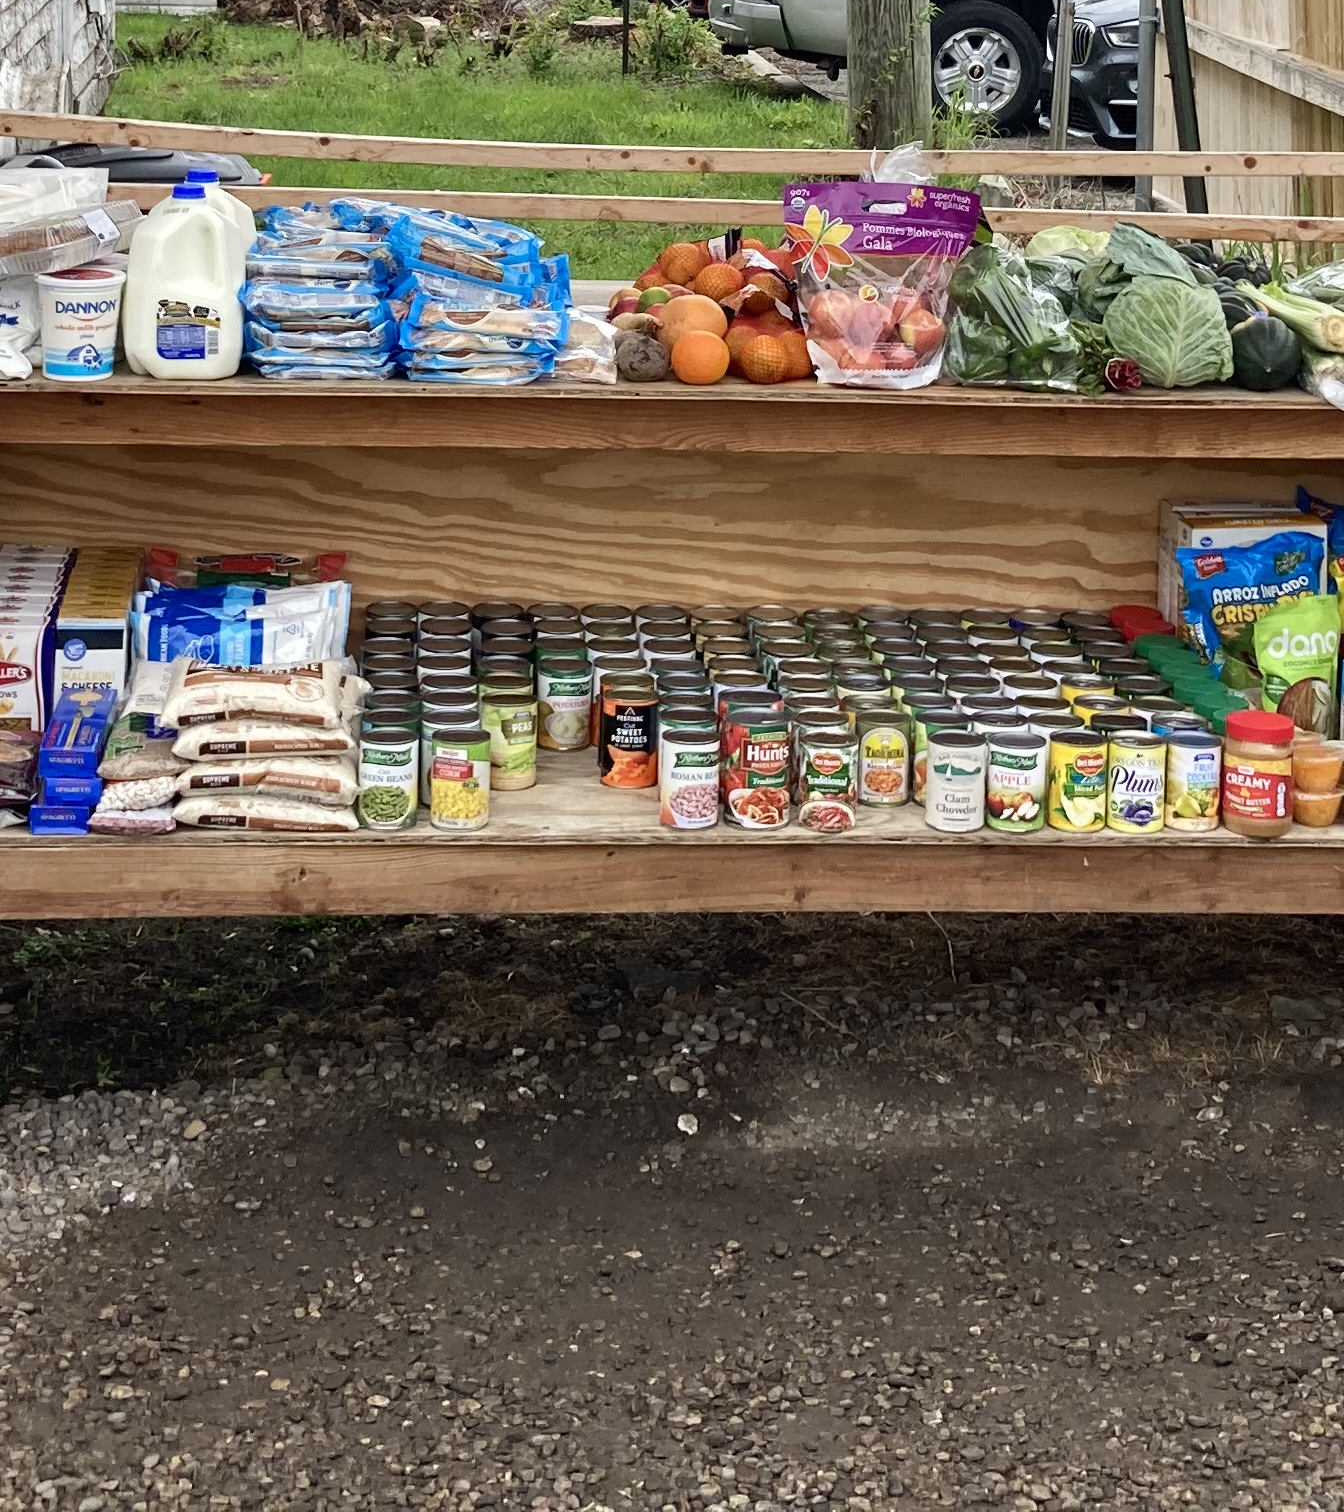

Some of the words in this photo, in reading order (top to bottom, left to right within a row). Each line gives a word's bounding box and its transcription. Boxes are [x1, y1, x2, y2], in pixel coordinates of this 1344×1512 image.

[929, 191, 972, 206] superfresh
[934, 200, 972, 213] organics
[862, 223, 905, 237] Pommes
[906, 226, 967, 241] Biologiques
[862, 236, 894, 251] Gala
[55, 299, 119, 315] DANNON
[1212, 587, 1259, 606] ARROZ
[1212, 601, 1276, 625] CRISP
[511, 720, 534, 734] PEAS
[616, 728, 643, 737] SWEET
[210, 742, 236, 751] SUPREME
[610, 735, 648, 744] POTATOES
[202, 775, 230, 784] SUPREME
[386, 773, 413, 782] BEANS
[670, 770, 703, 780] ROMAN
[992, 772, 1032, 786] APPLE
[1111, 765, 1164, 793] Plums
[1226, 772, 1271, 791] CREAMY
[944, 793, 971, 804] Clam
[1225, 790, 1245, 804] PEANUT
[1246, 797, 1271, 807] BUTTER
[935, 803, 978, 815] Chowder
